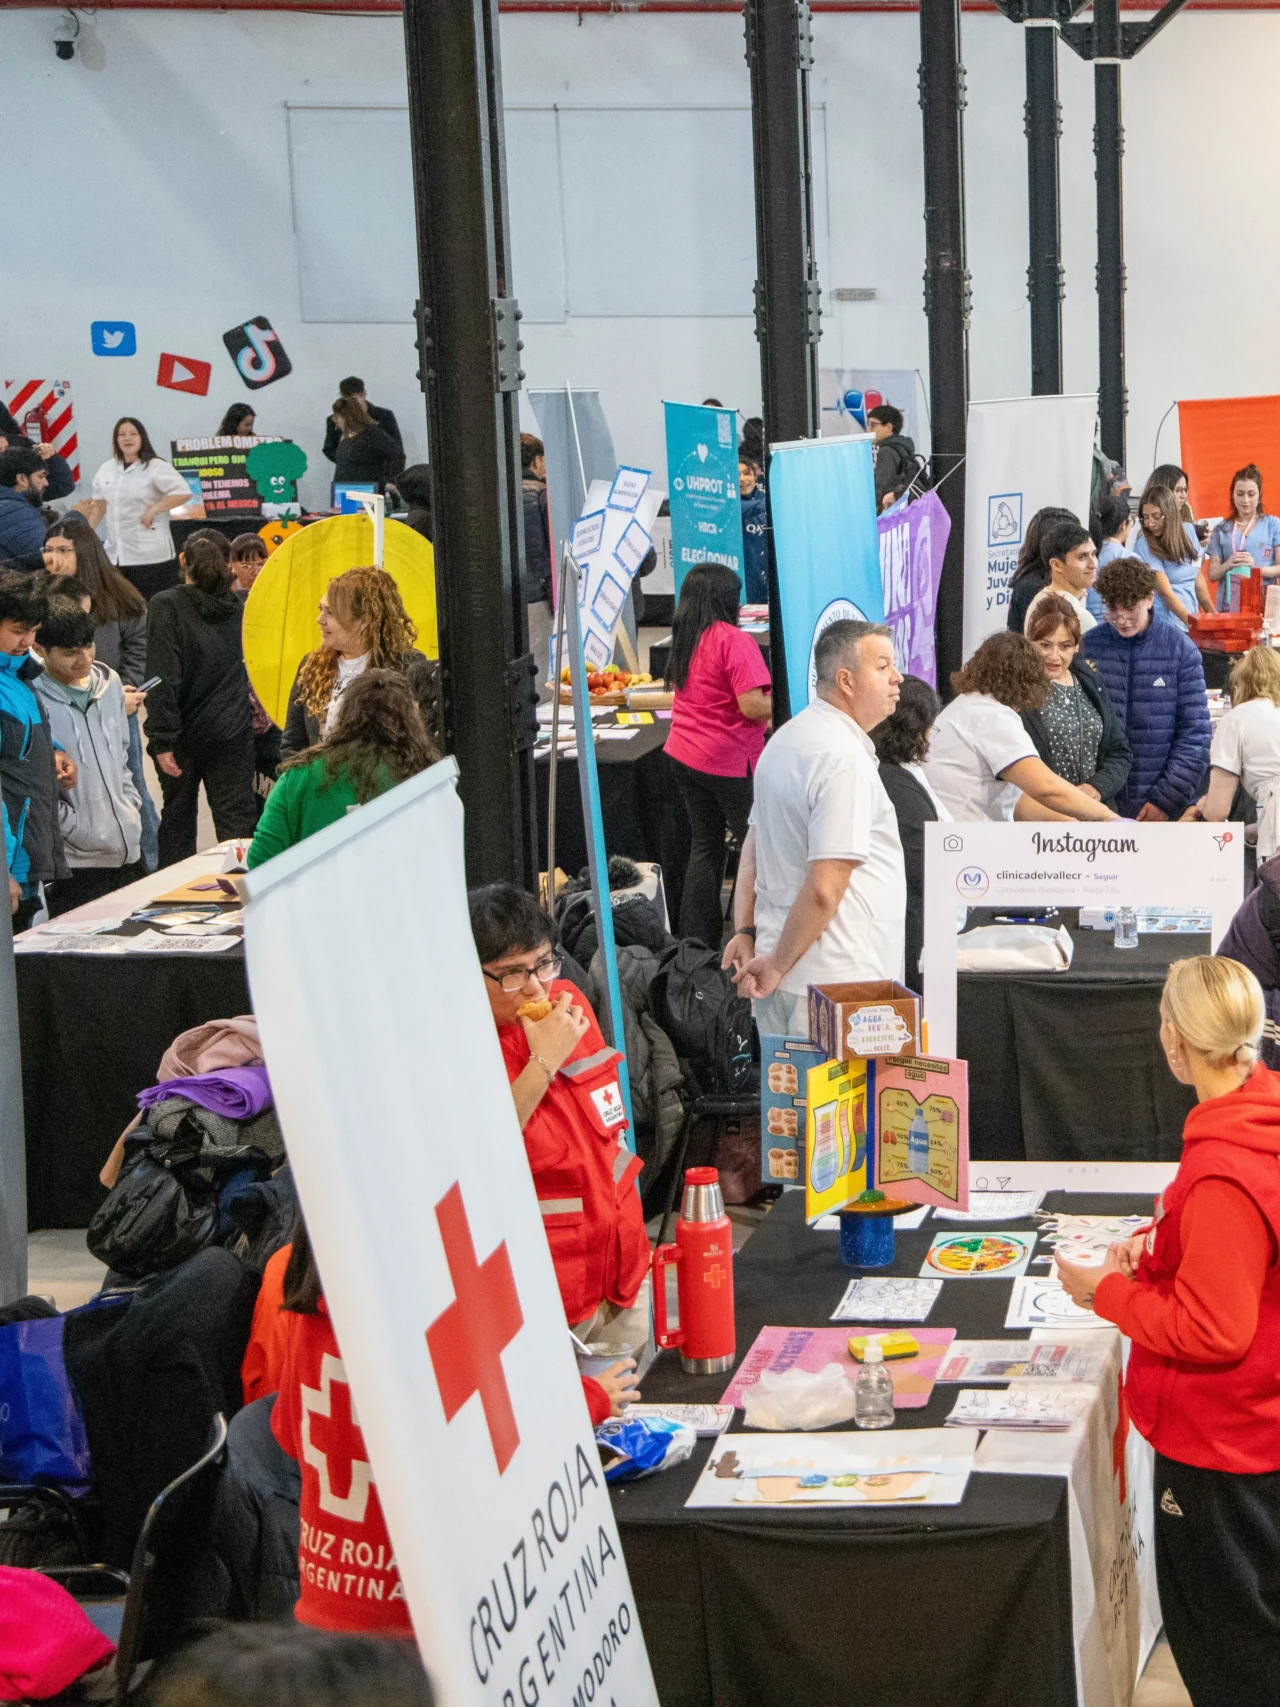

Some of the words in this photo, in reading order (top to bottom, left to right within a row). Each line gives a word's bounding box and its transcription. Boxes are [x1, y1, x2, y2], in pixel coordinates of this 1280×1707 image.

[686, 475, 723, 494] UHPROT
[988, 557, 1017, 575] Muje
[986, 597, 993, 611] y
[996, 590, 1011, 605] Di
[1032, 832, 1139, 862] Instagram
[996, 870, 1082, 880] clinicadelvallecr
[1093, 872, 1119, 881] Seguir
[996, 885, 1036, 894] Comodoro
[1038, 885, 1075, 894] Rivadavia
[1083, 885, 1103, 894] Rada
[1105, 885, 1121, 895] Tilly
[914, 1059, 947, 1071] necesitas
[907, 1071, 924, 1080] agua
[910, 1135, 928, 1146] Agua
[769, 1331, 815, 1374] ACTERIAS
[301, 1516, 336, 1560] RUZ
[470, 1536, 537, 1685] CRUZ
[531, 1443, 599, 1573] ROJA
[503, 1523, 617, 1707] GENTINA
[572, 1602, 631, 1707] MODORO
